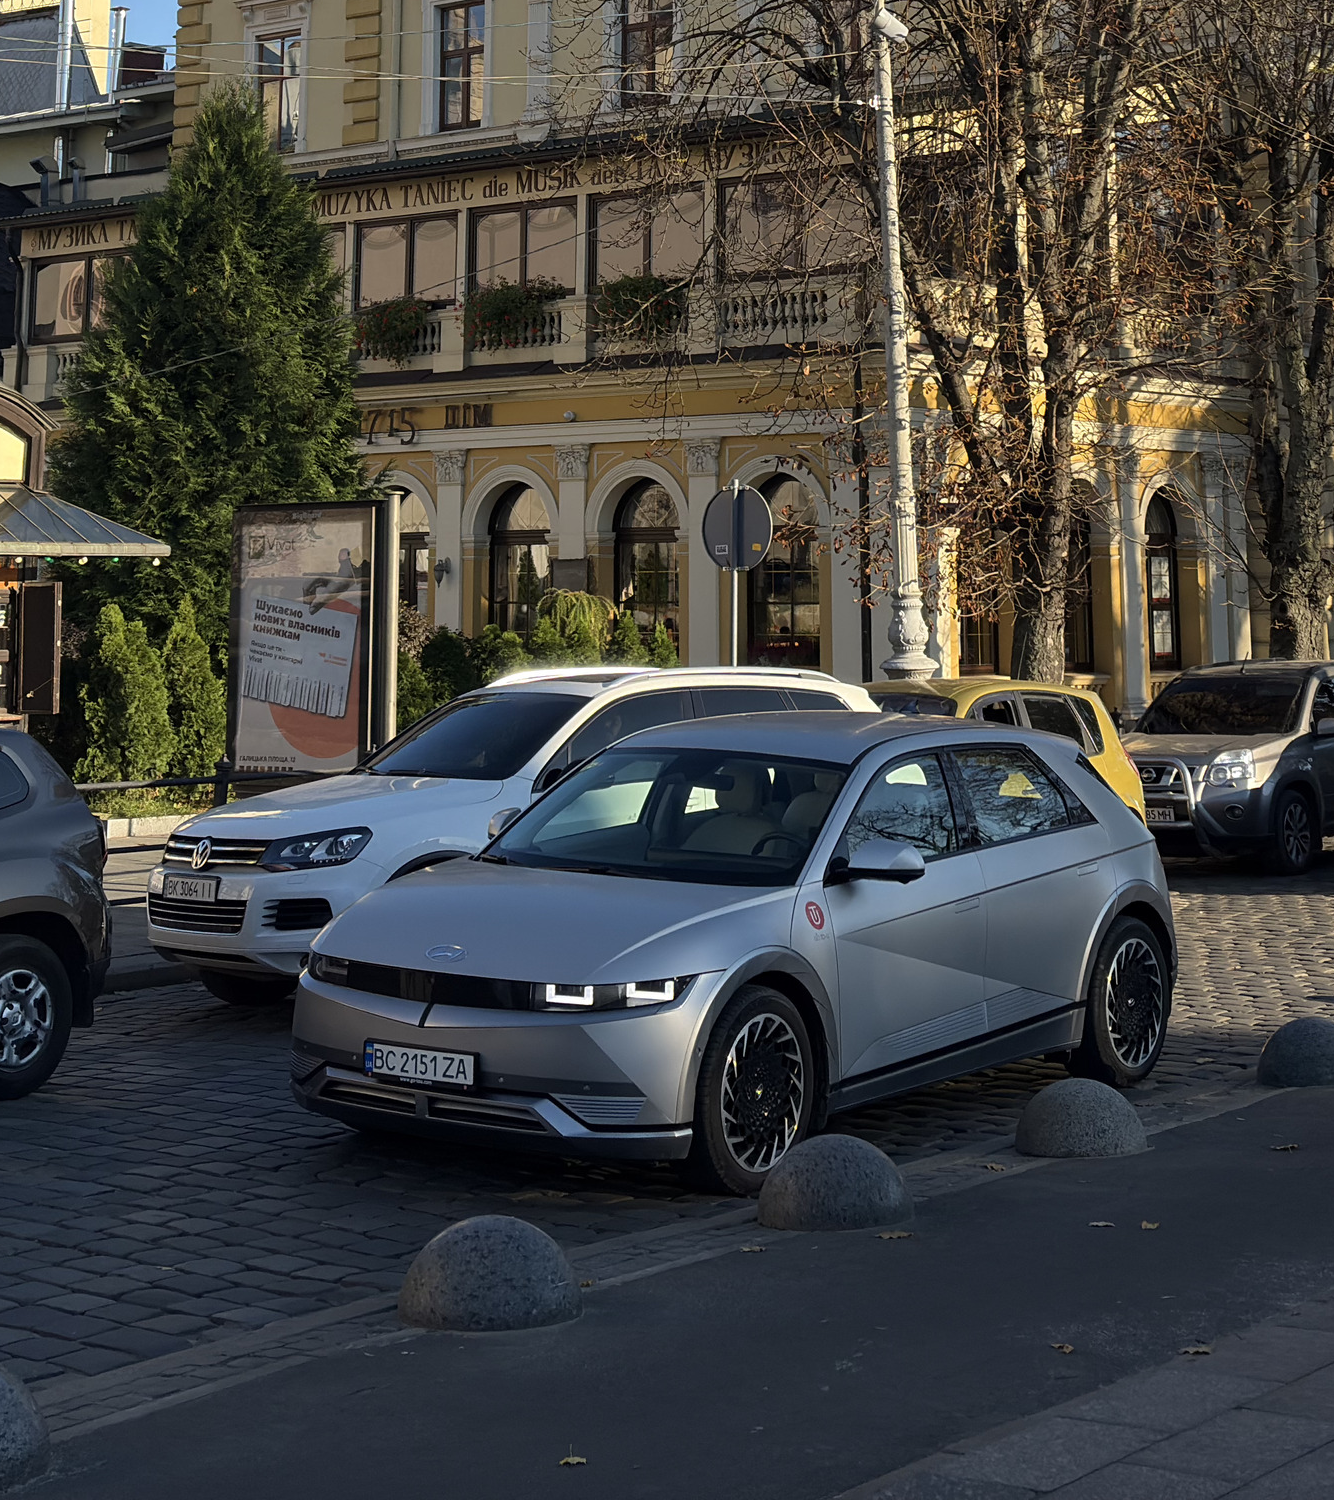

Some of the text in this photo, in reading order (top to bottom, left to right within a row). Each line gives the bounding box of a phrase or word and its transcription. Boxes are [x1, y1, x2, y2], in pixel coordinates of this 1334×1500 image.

[483, 175, 509, 199] die
[38, 221, 109, 251] МУЗИКА
[255, 598, 304, 619] Шукаємо
[252, 623, 301, 642] книжкам
[254, 612, 342, 639] нових власників
[1157, 809, 1171, 820] MH
[168, 880, 179, 896] BK
[179, 880, 199, 898] 3064
[373, 1048, 468, 1080] BC 2151 ZA
